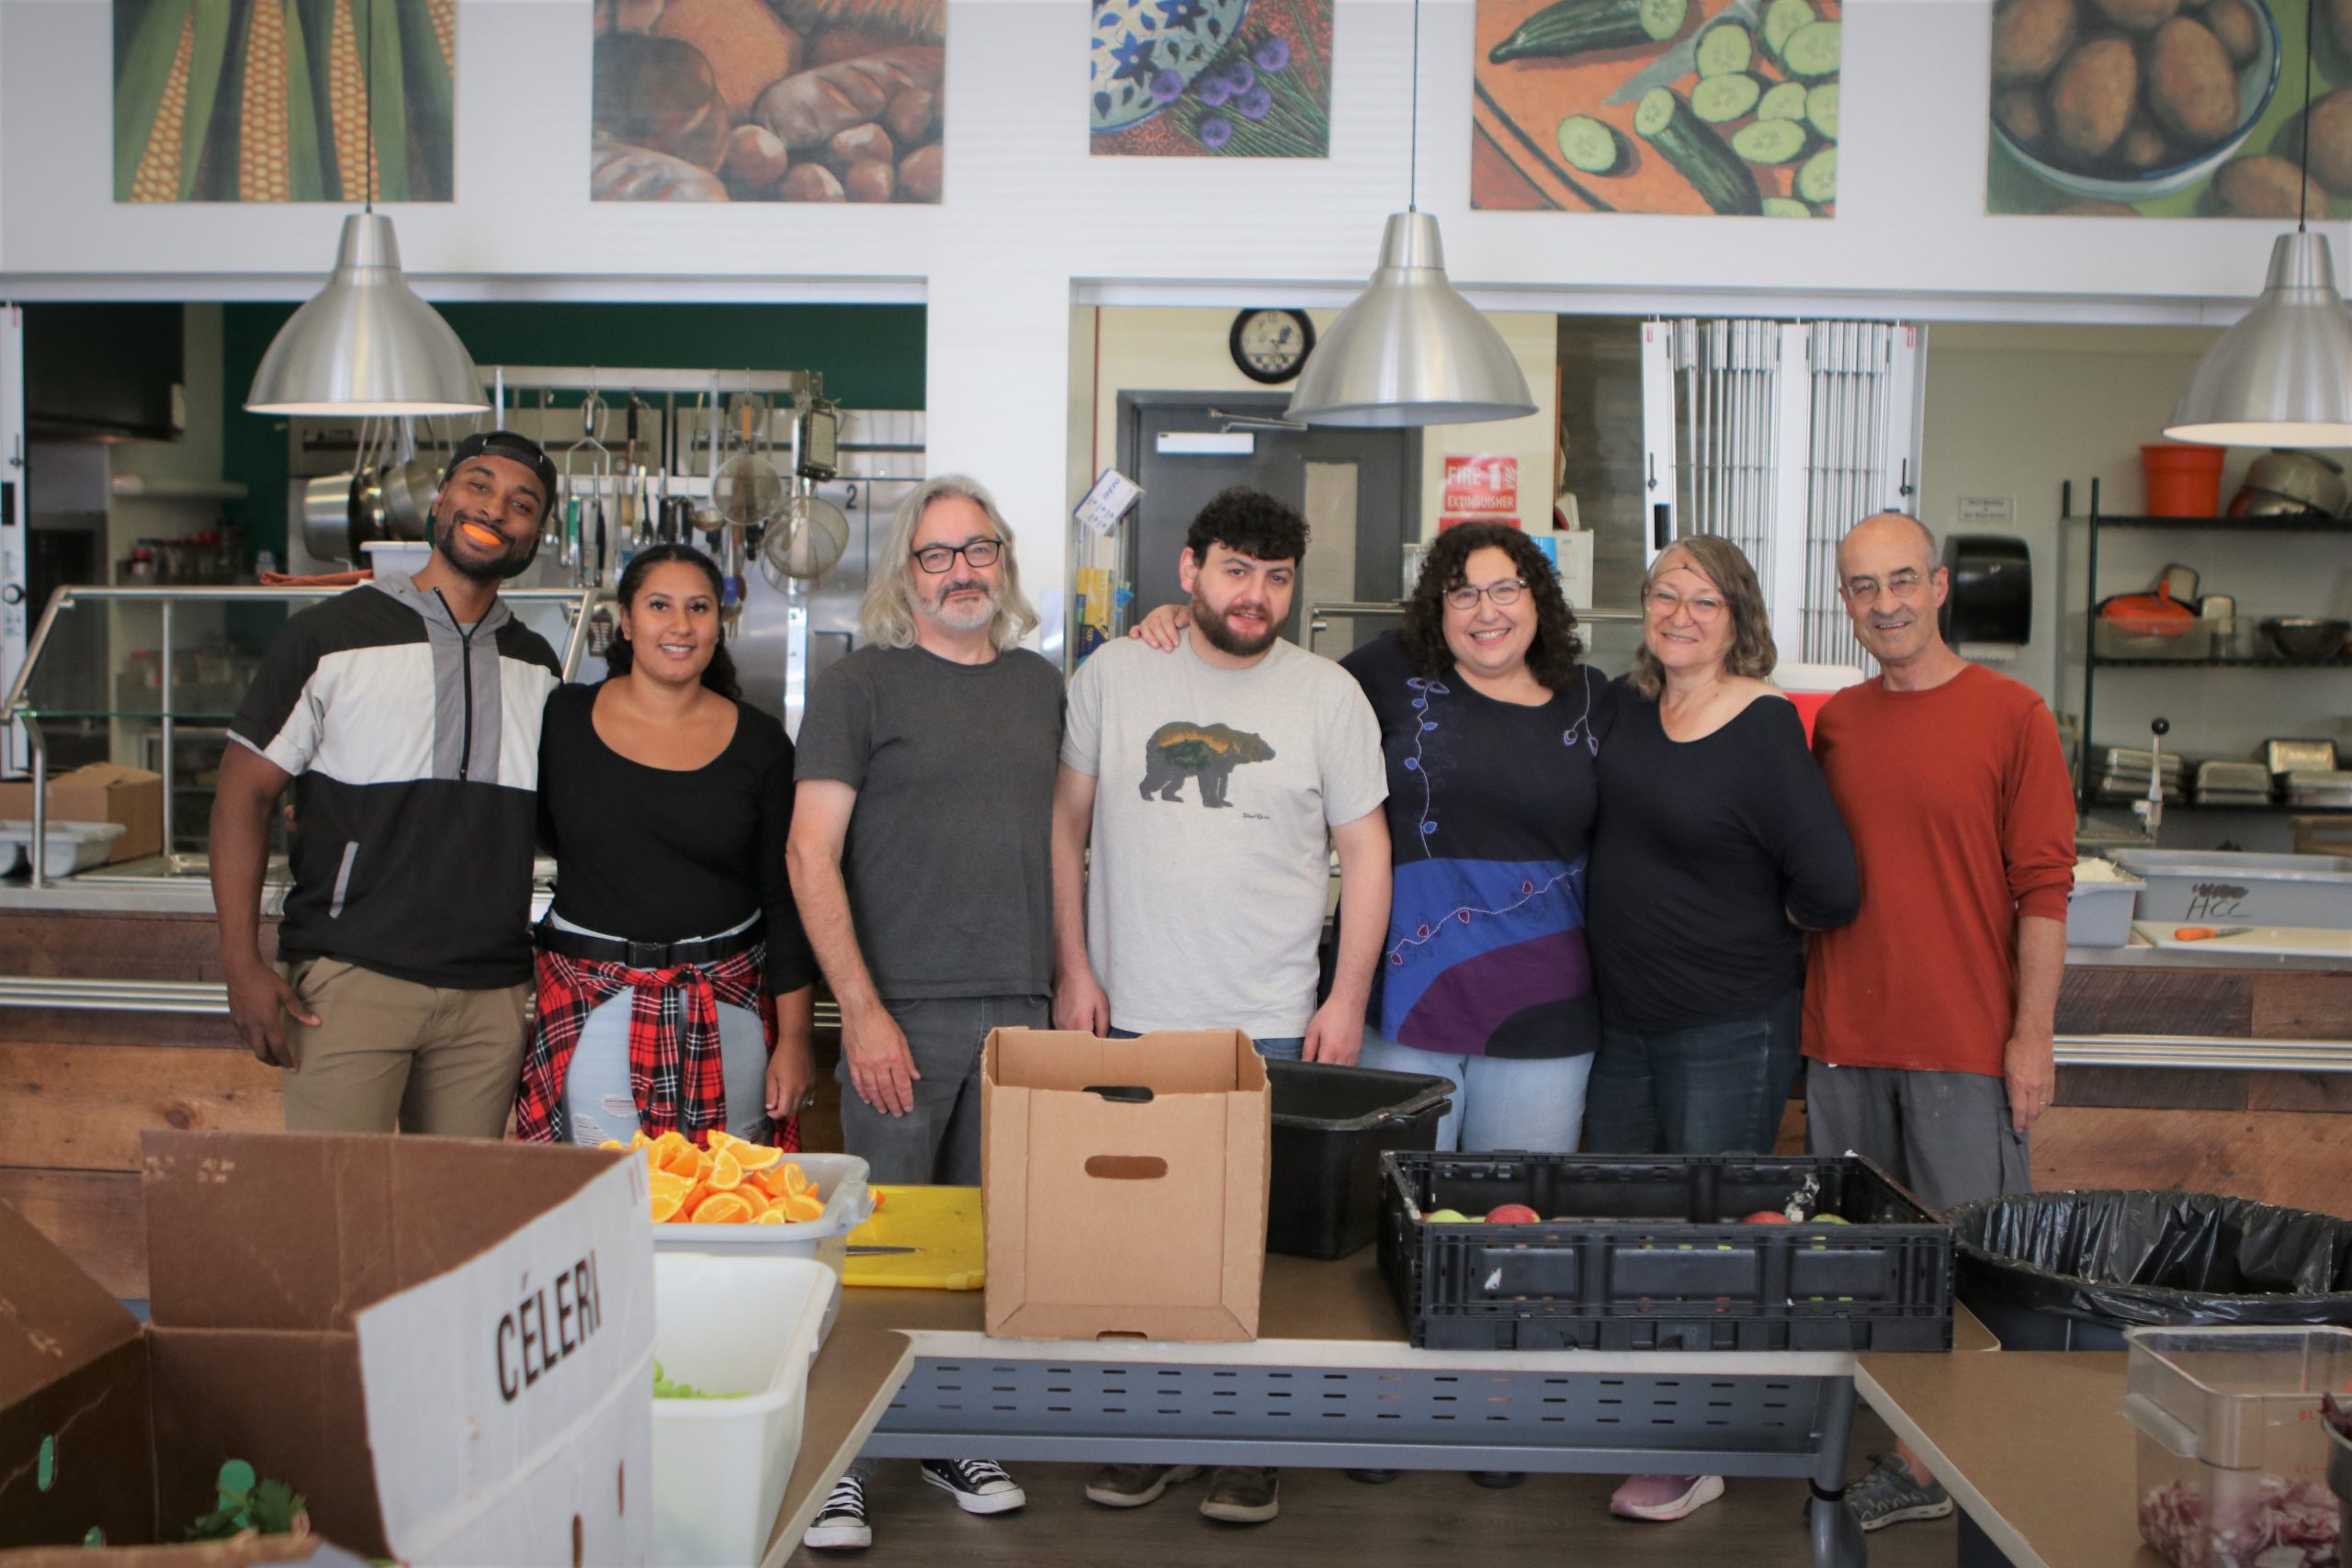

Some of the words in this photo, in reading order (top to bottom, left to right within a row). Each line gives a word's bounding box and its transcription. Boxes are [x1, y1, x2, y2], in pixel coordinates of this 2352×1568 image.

[1445, 466, 1481, 486] FIRE
[845, 483, 857, 509] 2
[1447, 496, 1515, 508] EXTINGUISHER
[497, 1248, 602, 1403] CÉLERI
